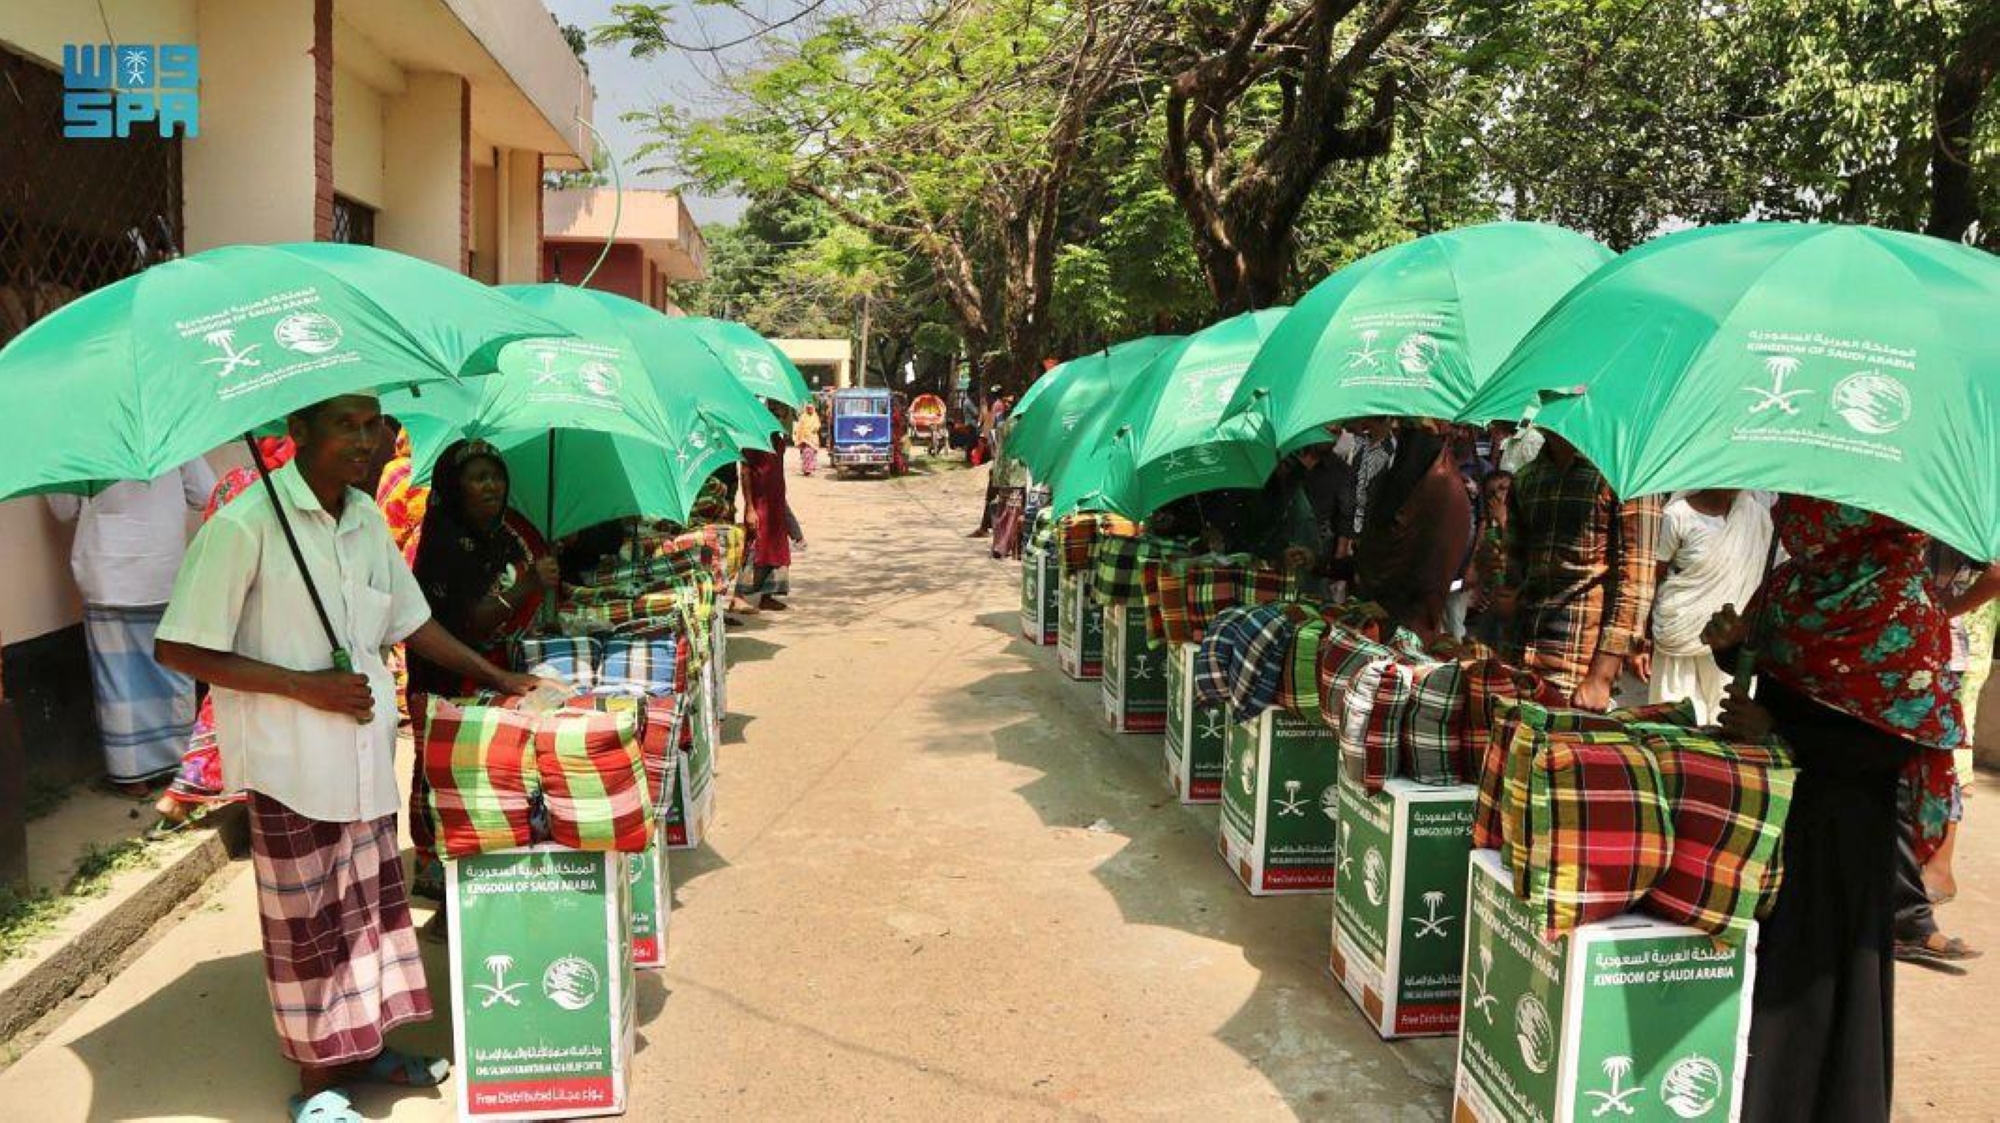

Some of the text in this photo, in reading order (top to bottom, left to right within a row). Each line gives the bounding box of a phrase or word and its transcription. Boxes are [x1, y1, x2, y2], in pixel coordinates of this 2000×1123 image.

[1747, 342, 1916, 371] KINGDOM OF SAUDI ARABIA
[515, 881, 530, 892] OF
[1595, 951, 1650, 970] السعودية
[1651, 949, 1690, 967] العربية
[1594, 966, 1734, 987] KINGDOM OF SAUDI ARABIA
